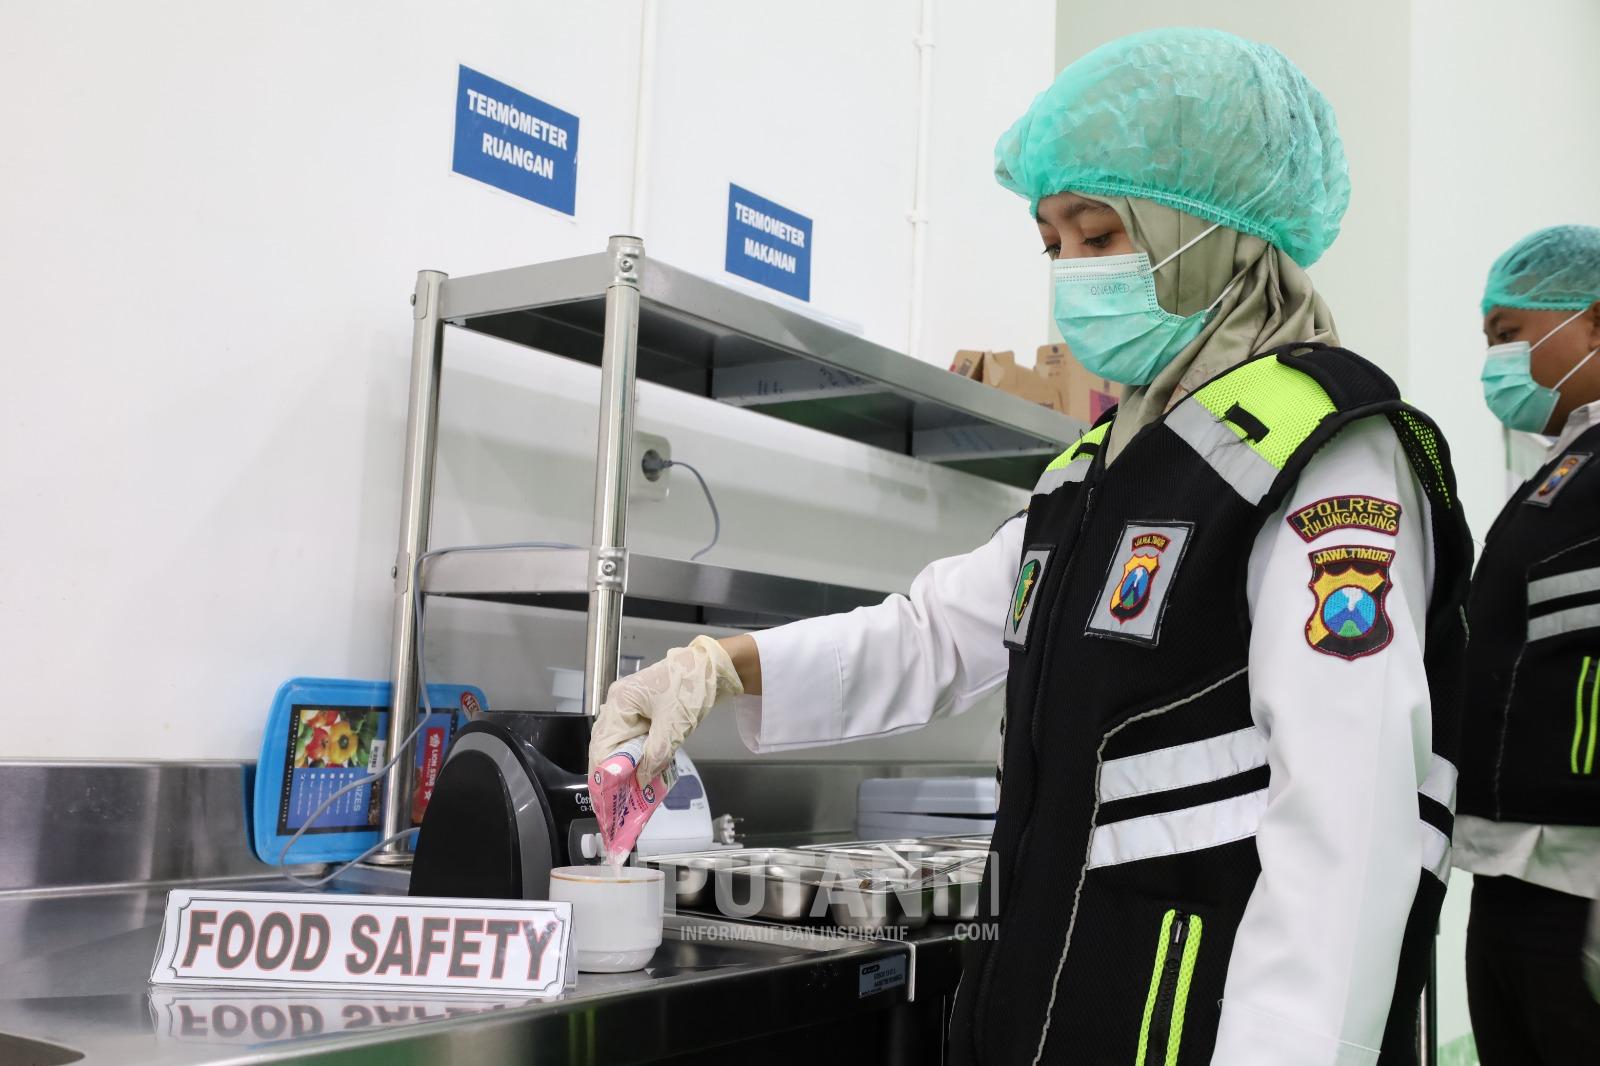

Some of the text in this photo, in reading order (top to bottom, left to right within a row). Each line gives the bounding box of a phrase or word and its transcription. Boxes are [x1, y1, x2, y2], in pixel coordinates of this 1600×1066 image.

[467, 88, 568, 150] TERMOMETER
[482, 132, 554, 180] RUANGAN
[735, 201, 805, 248] TERMOMETER
[744, 237, 796, 274] MAKANAN
[1299, 498, 1398, 526] POLRES
[1302, 512, 1396, 537] TULUNGAGUNG
[1315, 548, 1388, 564] JAWA TIMUR
[425, 767, 437, 787] STAR
[181, 909, 558, 981] FOOD SAFETY
